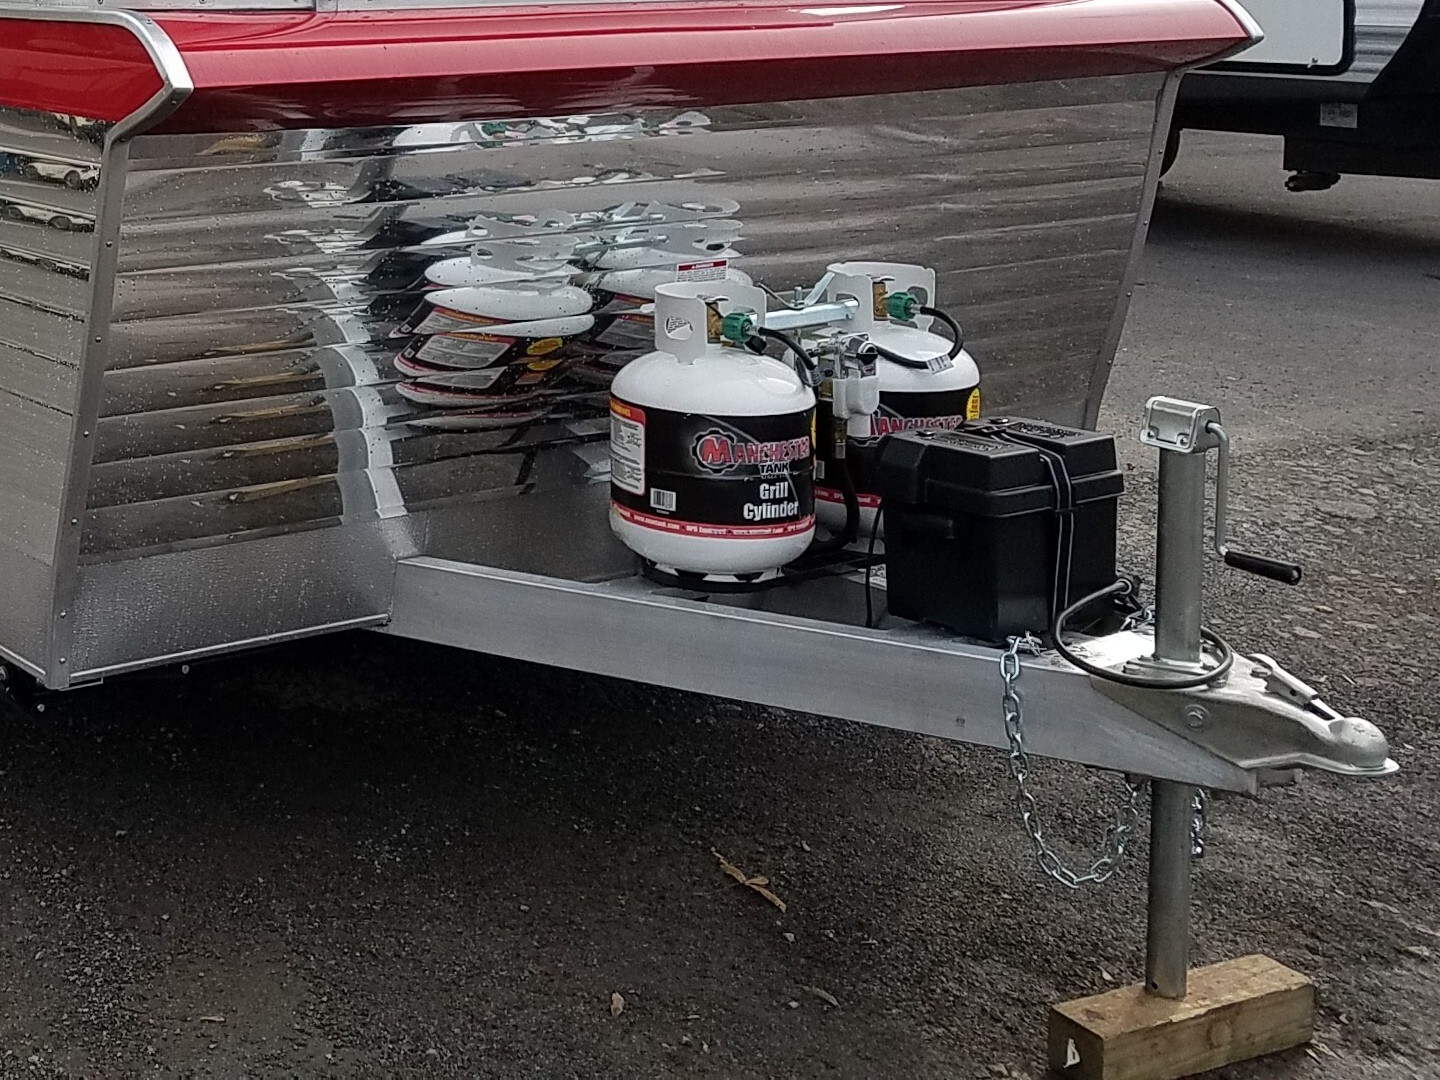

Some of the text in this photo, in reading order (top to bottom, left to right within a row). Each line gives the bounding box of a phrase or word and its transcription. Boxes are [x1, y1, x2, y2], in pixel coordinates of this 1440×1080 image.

[759, 462, 789, 475] TANK
[759, 481, 789, 500] Grill
[743, 500, 799, 522] Cylinder
